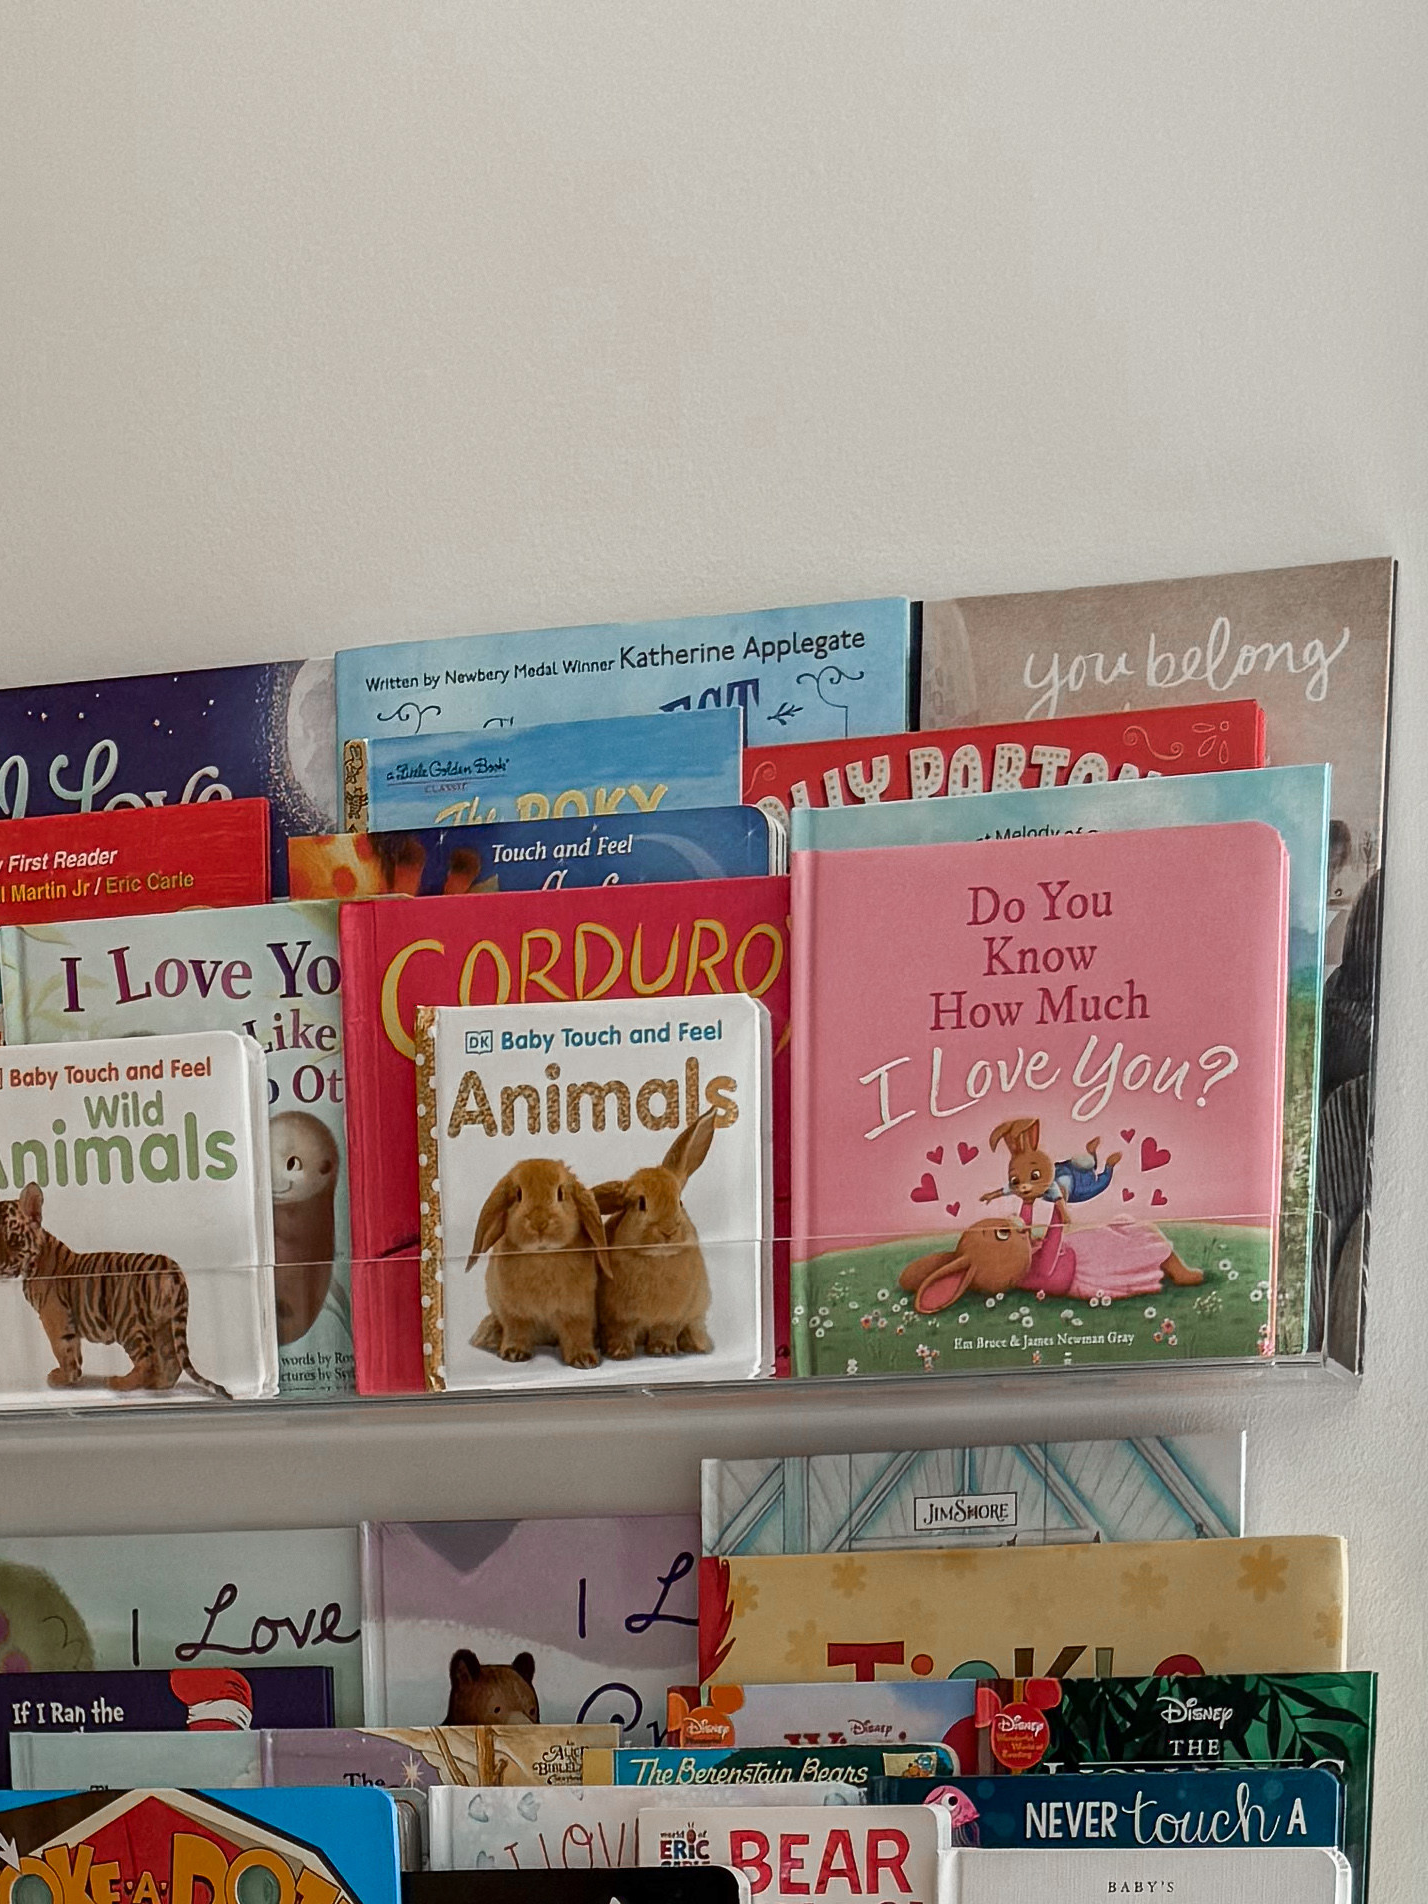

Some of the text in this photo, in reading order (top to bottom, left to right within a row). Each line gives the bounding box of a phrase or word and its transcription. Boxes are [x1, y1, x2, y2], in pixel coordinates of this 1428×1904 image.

[365, 626, 866, 692] Written by Newbery Medal Winner Katherine Applegate
[1021, 616, 1350, 705] you belong
[6, 852, 48, 875] First
[53, 848, 119, 869] Reader
[491, 834, 634, 864] Touch and Feel
[10, 880, 68, 903] Martin
[71, 879, 91, 899] Jr
[105, 874, 142, 895] Eric
[145, 870, 195, 892] Carle
[965, 880, 1114, 926] Do You
[983, 936, 1099, 977] Know
[928, 979, 1152, 1031] How Much
[500, 1030, 554, 1055] Baby
[560, 1025, 622, 1048] Touch
[629, 1022, 671, 1044] and
[677, 1019, 723, 1043] Feel
[9, 1065, 59, 1091] Baby
[65, 1061, 118, 1085] Touch
[125, 1059, 165, 1082] and
[170, 1056, 212, 1079] Feel
[859, 1033, 1241, 1141] I Love You?
[83, 1089, 164, 1130] Wild
[446, 1056, 740, 1139] Animals
[12, 1697, 125, 1724] If I Ran the
[994, 1713, 1045, 1738] Disney
[1168, 1738, 1221, 1757] THE
[628, 1756, 869, 1786] The Berenstain Bears
[1026, 1782, 1308, 1845] NEVER touch A
[660, 1840, 710, 1860] ERIC
[729, 1828, 914, 1896] BEAR
[1107, 1879, 1175, 1895] BABY'S
